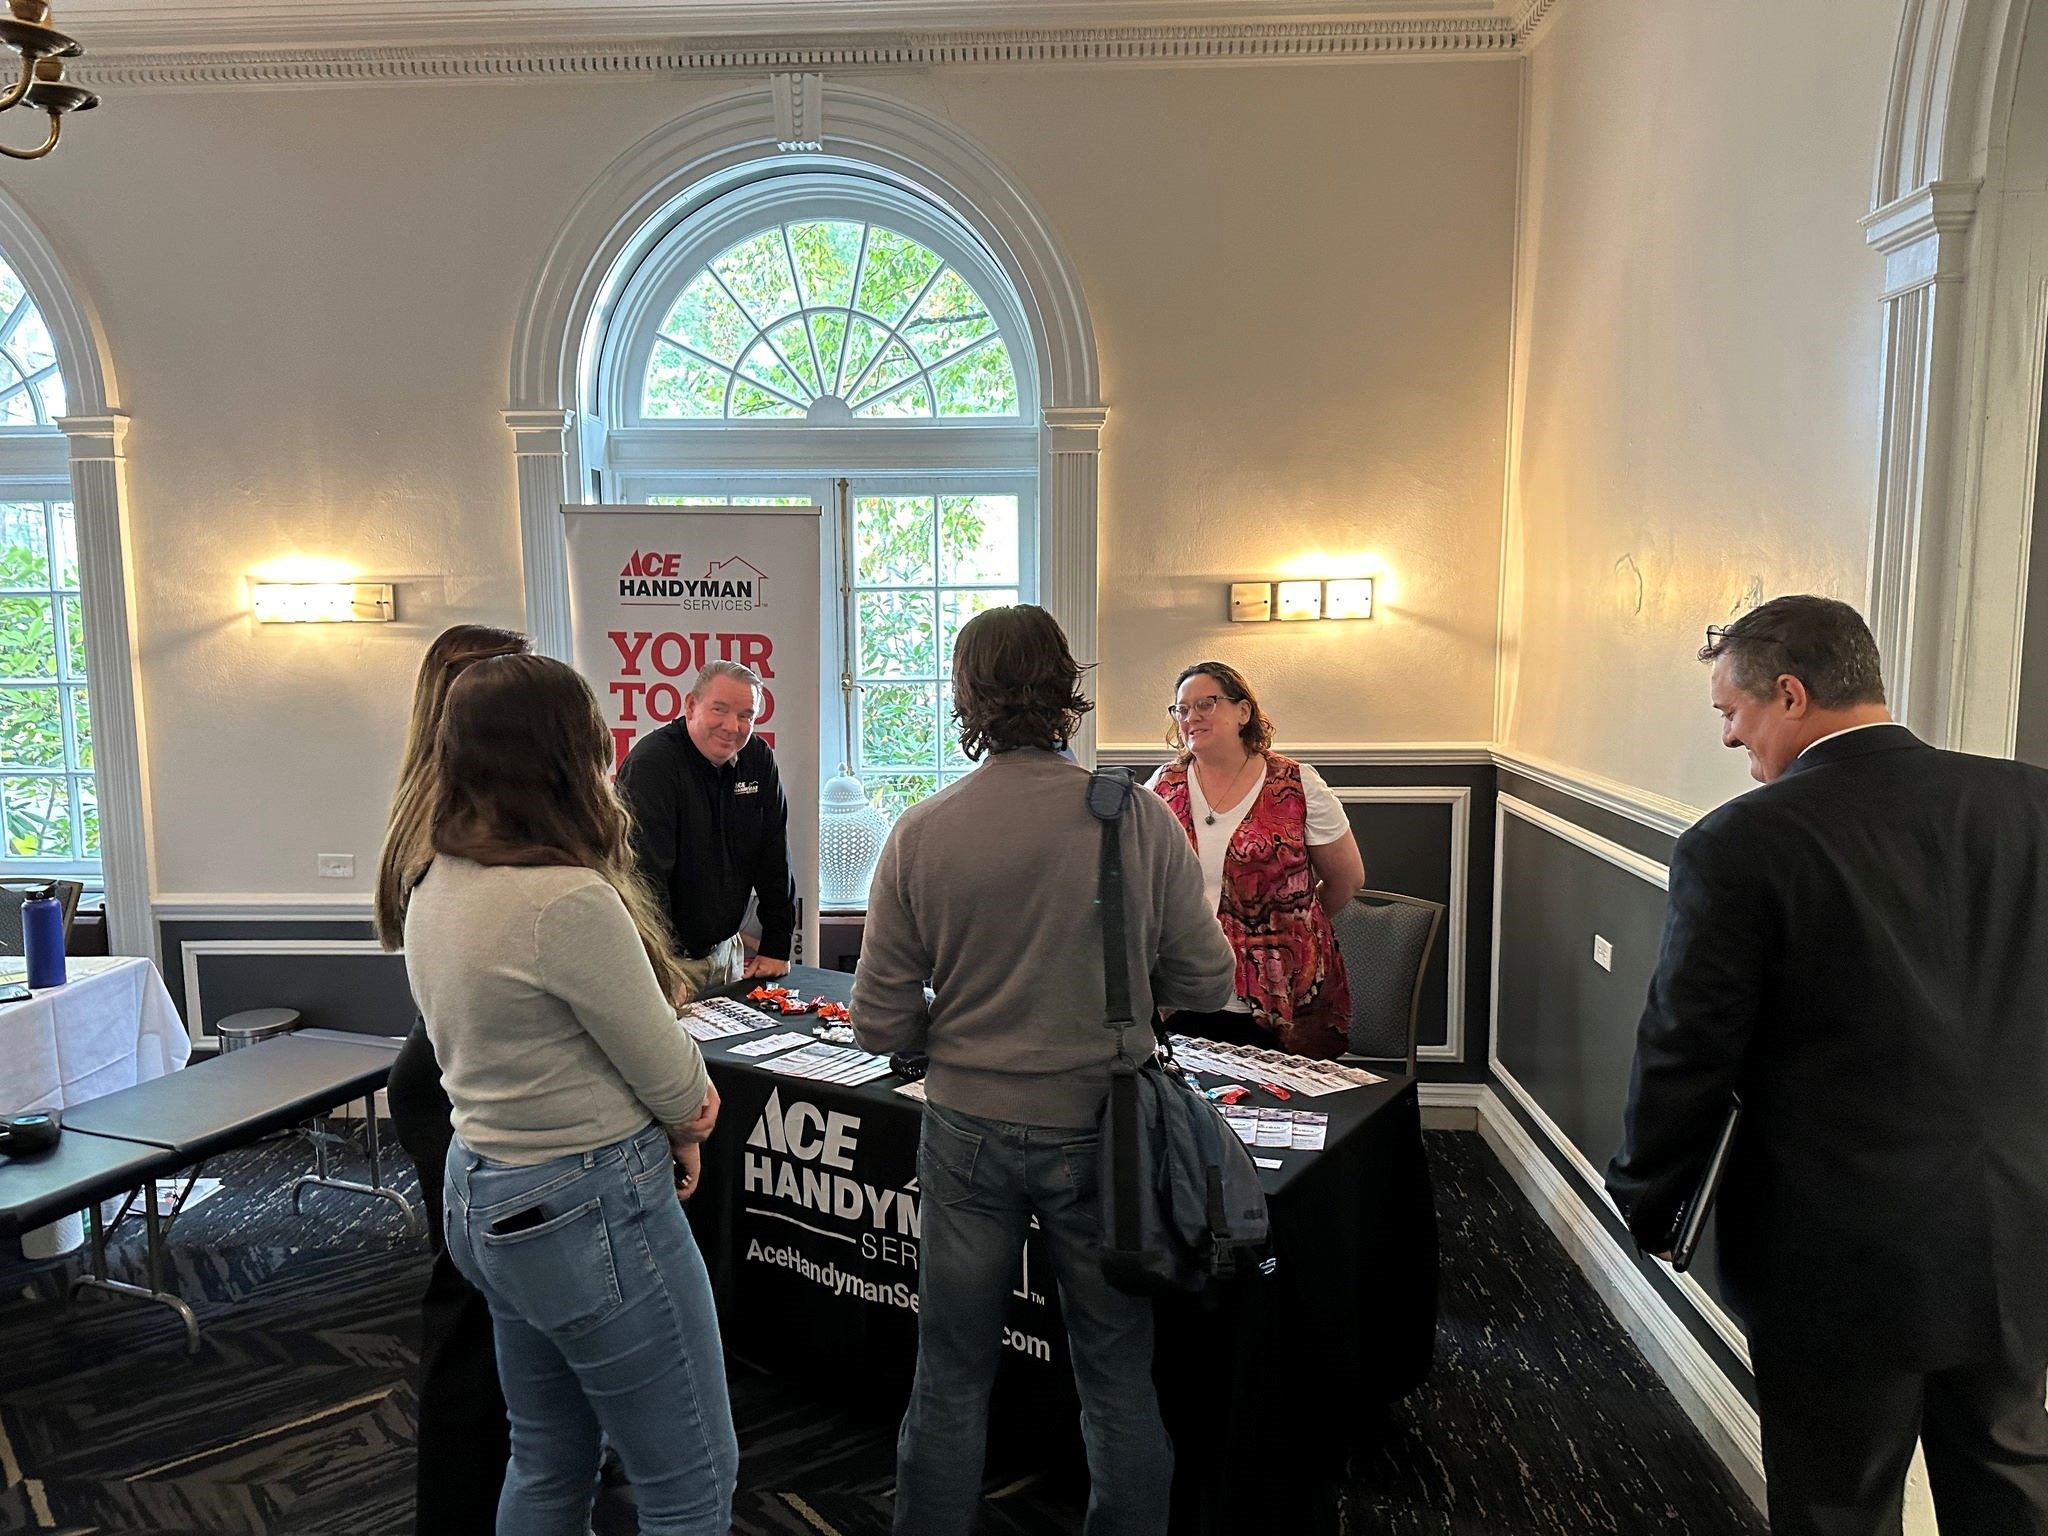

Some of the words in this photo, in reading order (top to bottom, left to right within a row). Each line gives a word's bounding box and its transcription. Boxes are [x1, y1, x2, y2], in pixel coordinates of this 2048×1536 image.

[620, 548, 682, 577] ACE
[619, 579, 753, 598] HANDYMAN
[683, 599, 753, 611] SERVICES
[608, 631, 776, 679] YOUR
[746, 1086, 861, 1171] ACE
[744, 1152, 921, 1238] HANDYM
